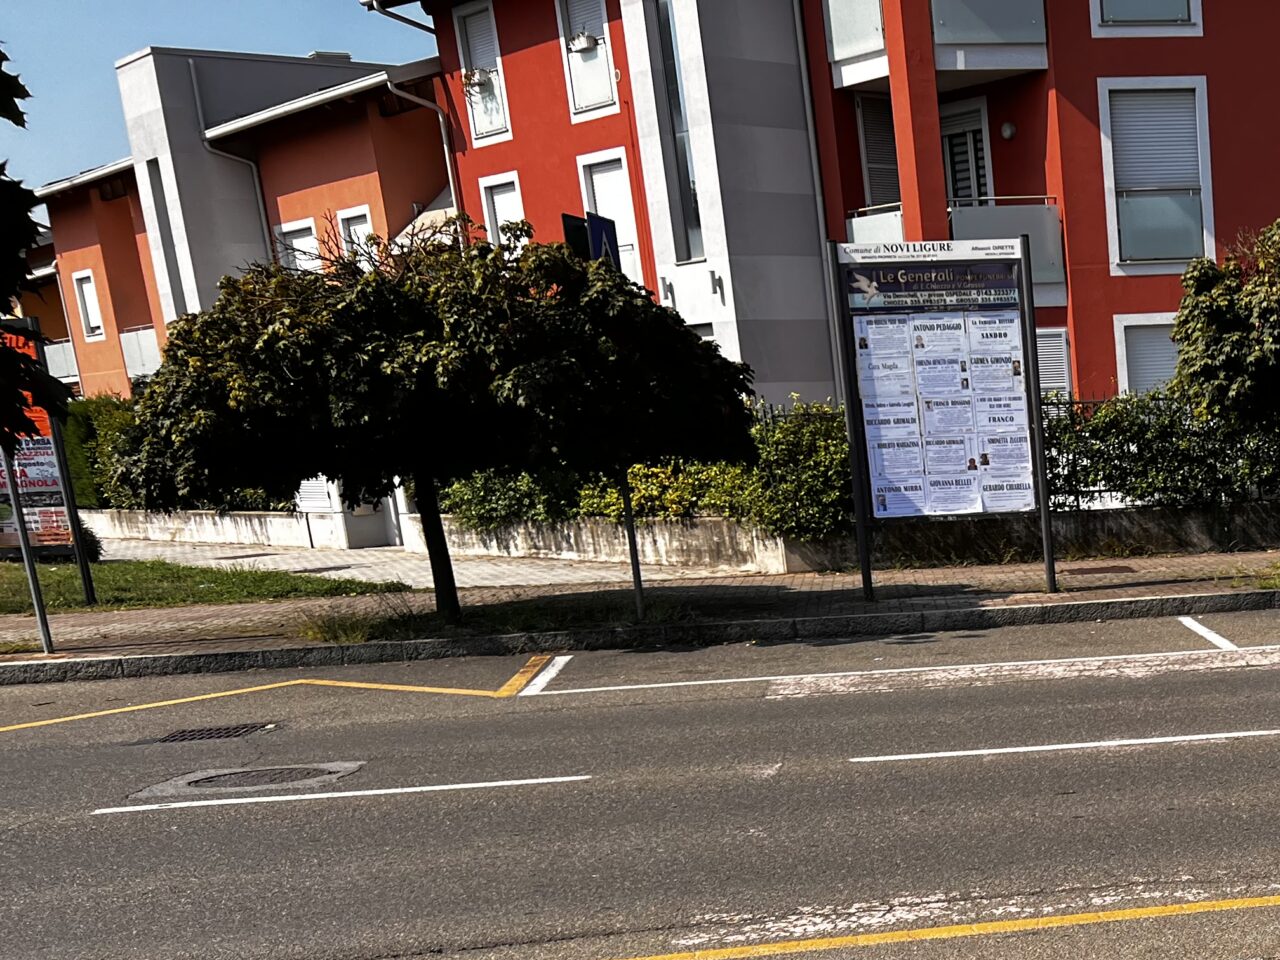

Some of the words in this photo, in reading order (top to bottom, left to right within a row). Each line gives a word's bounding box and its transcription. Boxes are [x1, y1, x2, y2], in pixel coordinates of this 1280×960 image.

[884, 243, 910, 252] NOVI
[913, 242, 953, 252] LIGURE
[880, 270, 894, 283] Le
[898, 268, 954, 283] Generali
[913, 324, 936, 332] ANTONIO
